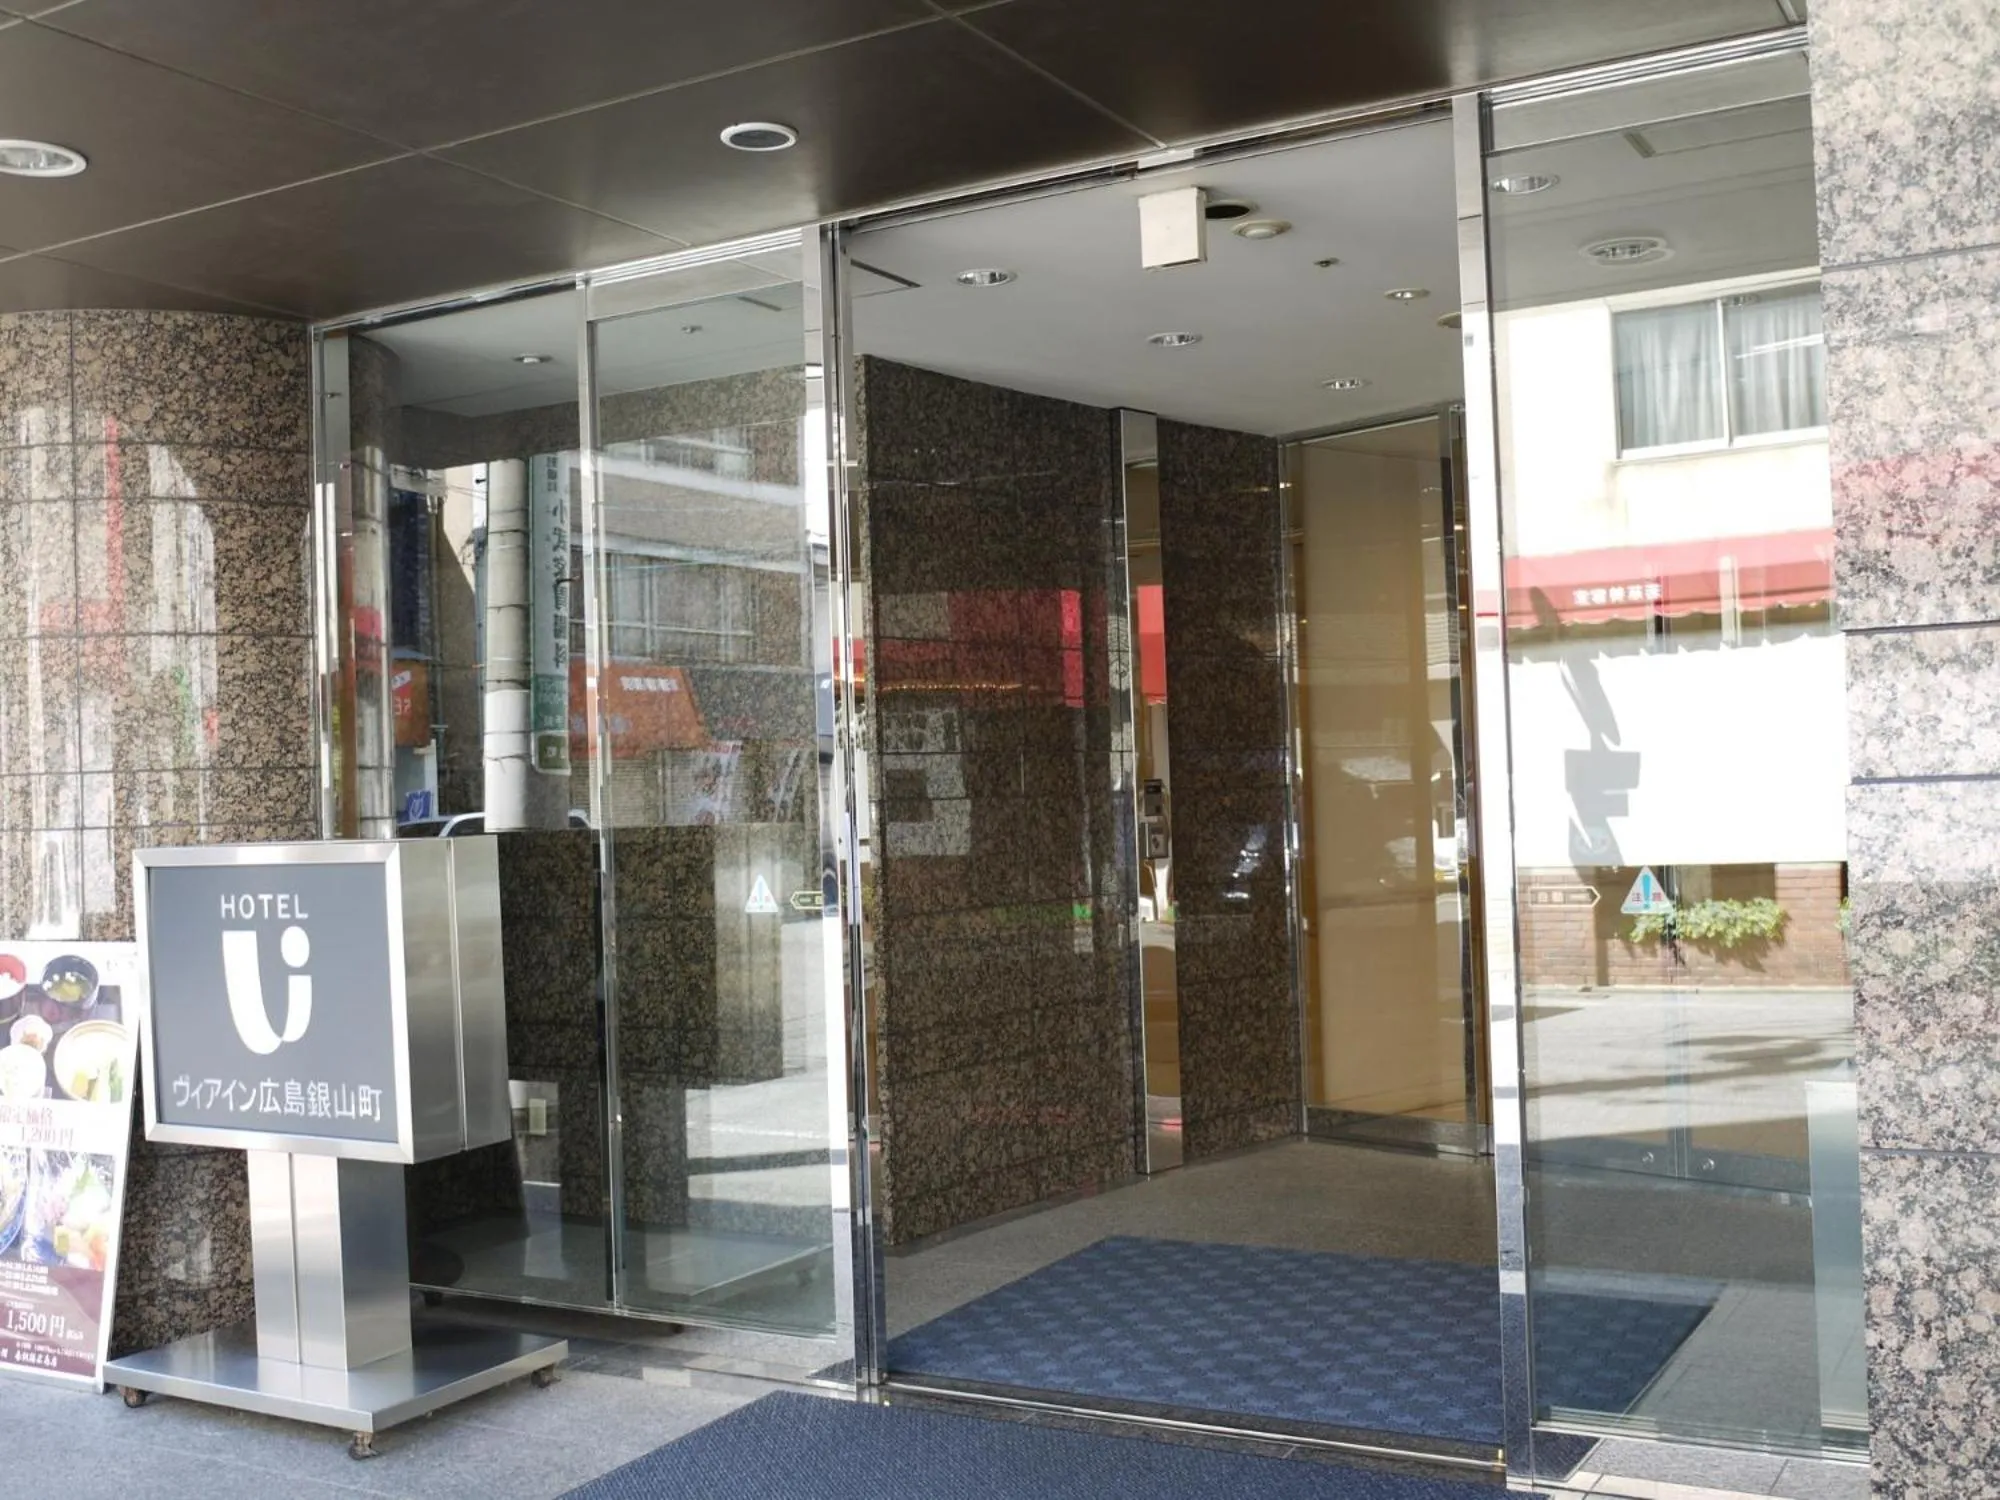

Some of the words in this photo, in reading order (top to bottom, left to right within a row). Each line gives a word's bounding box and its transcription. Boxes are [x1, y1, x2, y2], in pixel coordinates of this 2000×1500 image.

[220, 893, 309, 919] HOTEL
[172, 1074, 384, 1122] ヴィアイン広島銀山町
[7, 1309, 66, 1339] 1,500円
